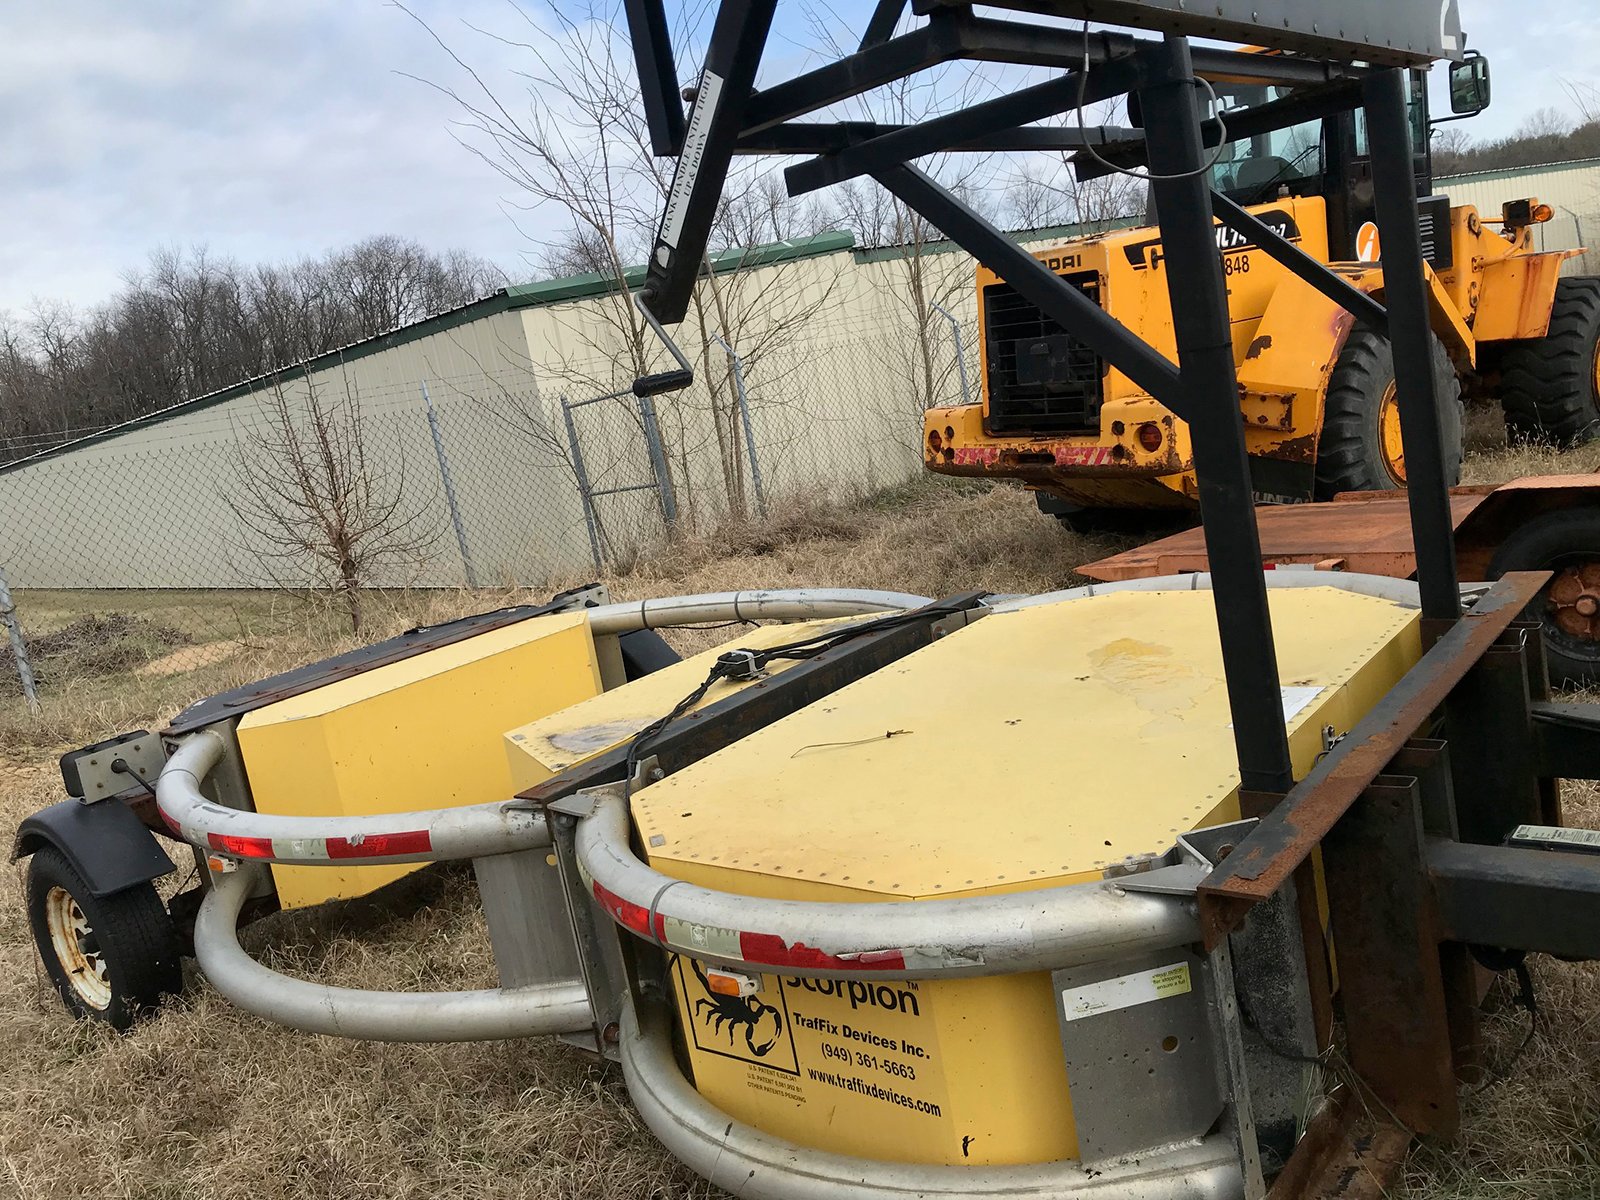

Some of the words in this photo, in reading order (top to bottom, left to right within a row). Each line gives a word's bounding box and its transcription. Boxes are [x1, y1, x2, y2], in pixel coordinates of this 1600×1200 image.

[662, 202, 677, 239] CRANK
[673, 151, 690, 198] HANDLE
[687, 114, 701, 149] UNTIL
[697, 72, 712, 110] TIGHT
[683, 181, 692, 197] UP
[692, 132, 706, 169] DOWN
[792, 1012, 839, 1036] TrafFix
[842, 1024, 898, 1051] Devices
[901, 1040, 931, 1059] Inc.
[821, 1042, 853, 1066] (949)
[856, 1052, 916, 1080] 361-5663
[807, 1068, 942, 1117] www.traffixdevices.com
